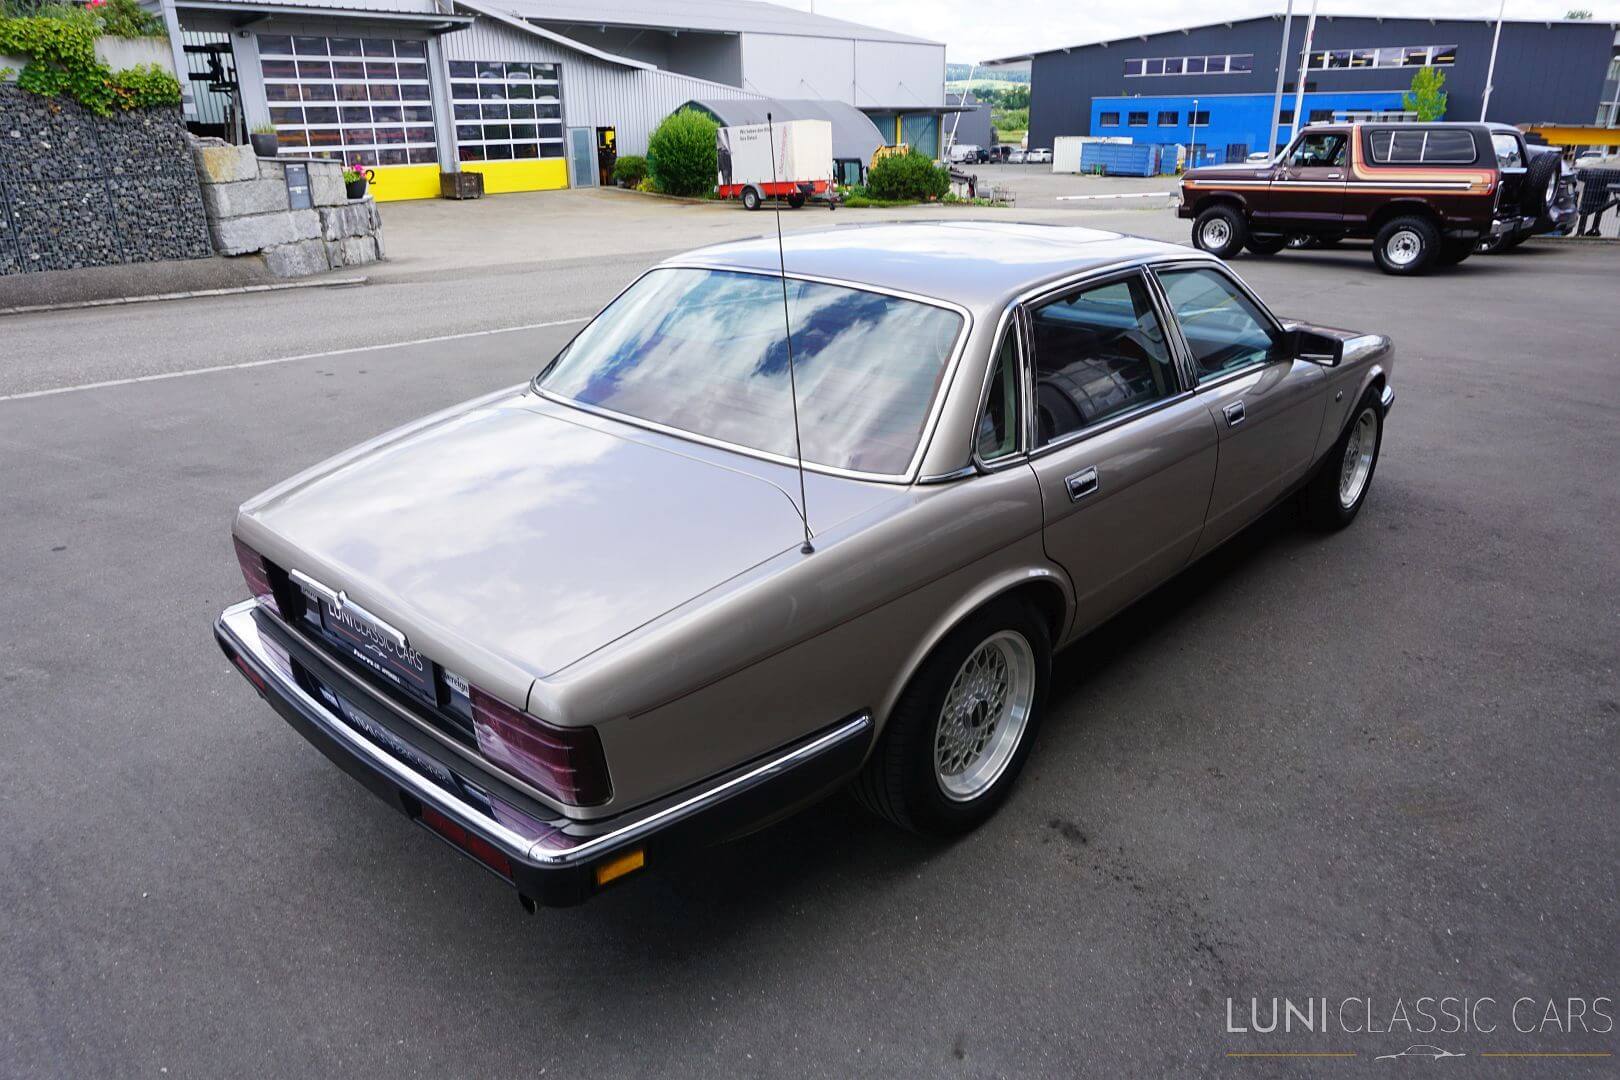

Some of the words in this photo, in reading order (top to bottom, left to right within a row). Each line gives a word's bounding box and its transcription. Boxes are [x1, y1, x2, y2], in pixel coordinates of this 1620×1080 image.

[328, 602, 354, 628] LUNI
[354, 617, 394, 653] CLASSIC
[396, 642, 423, 672] CARS
